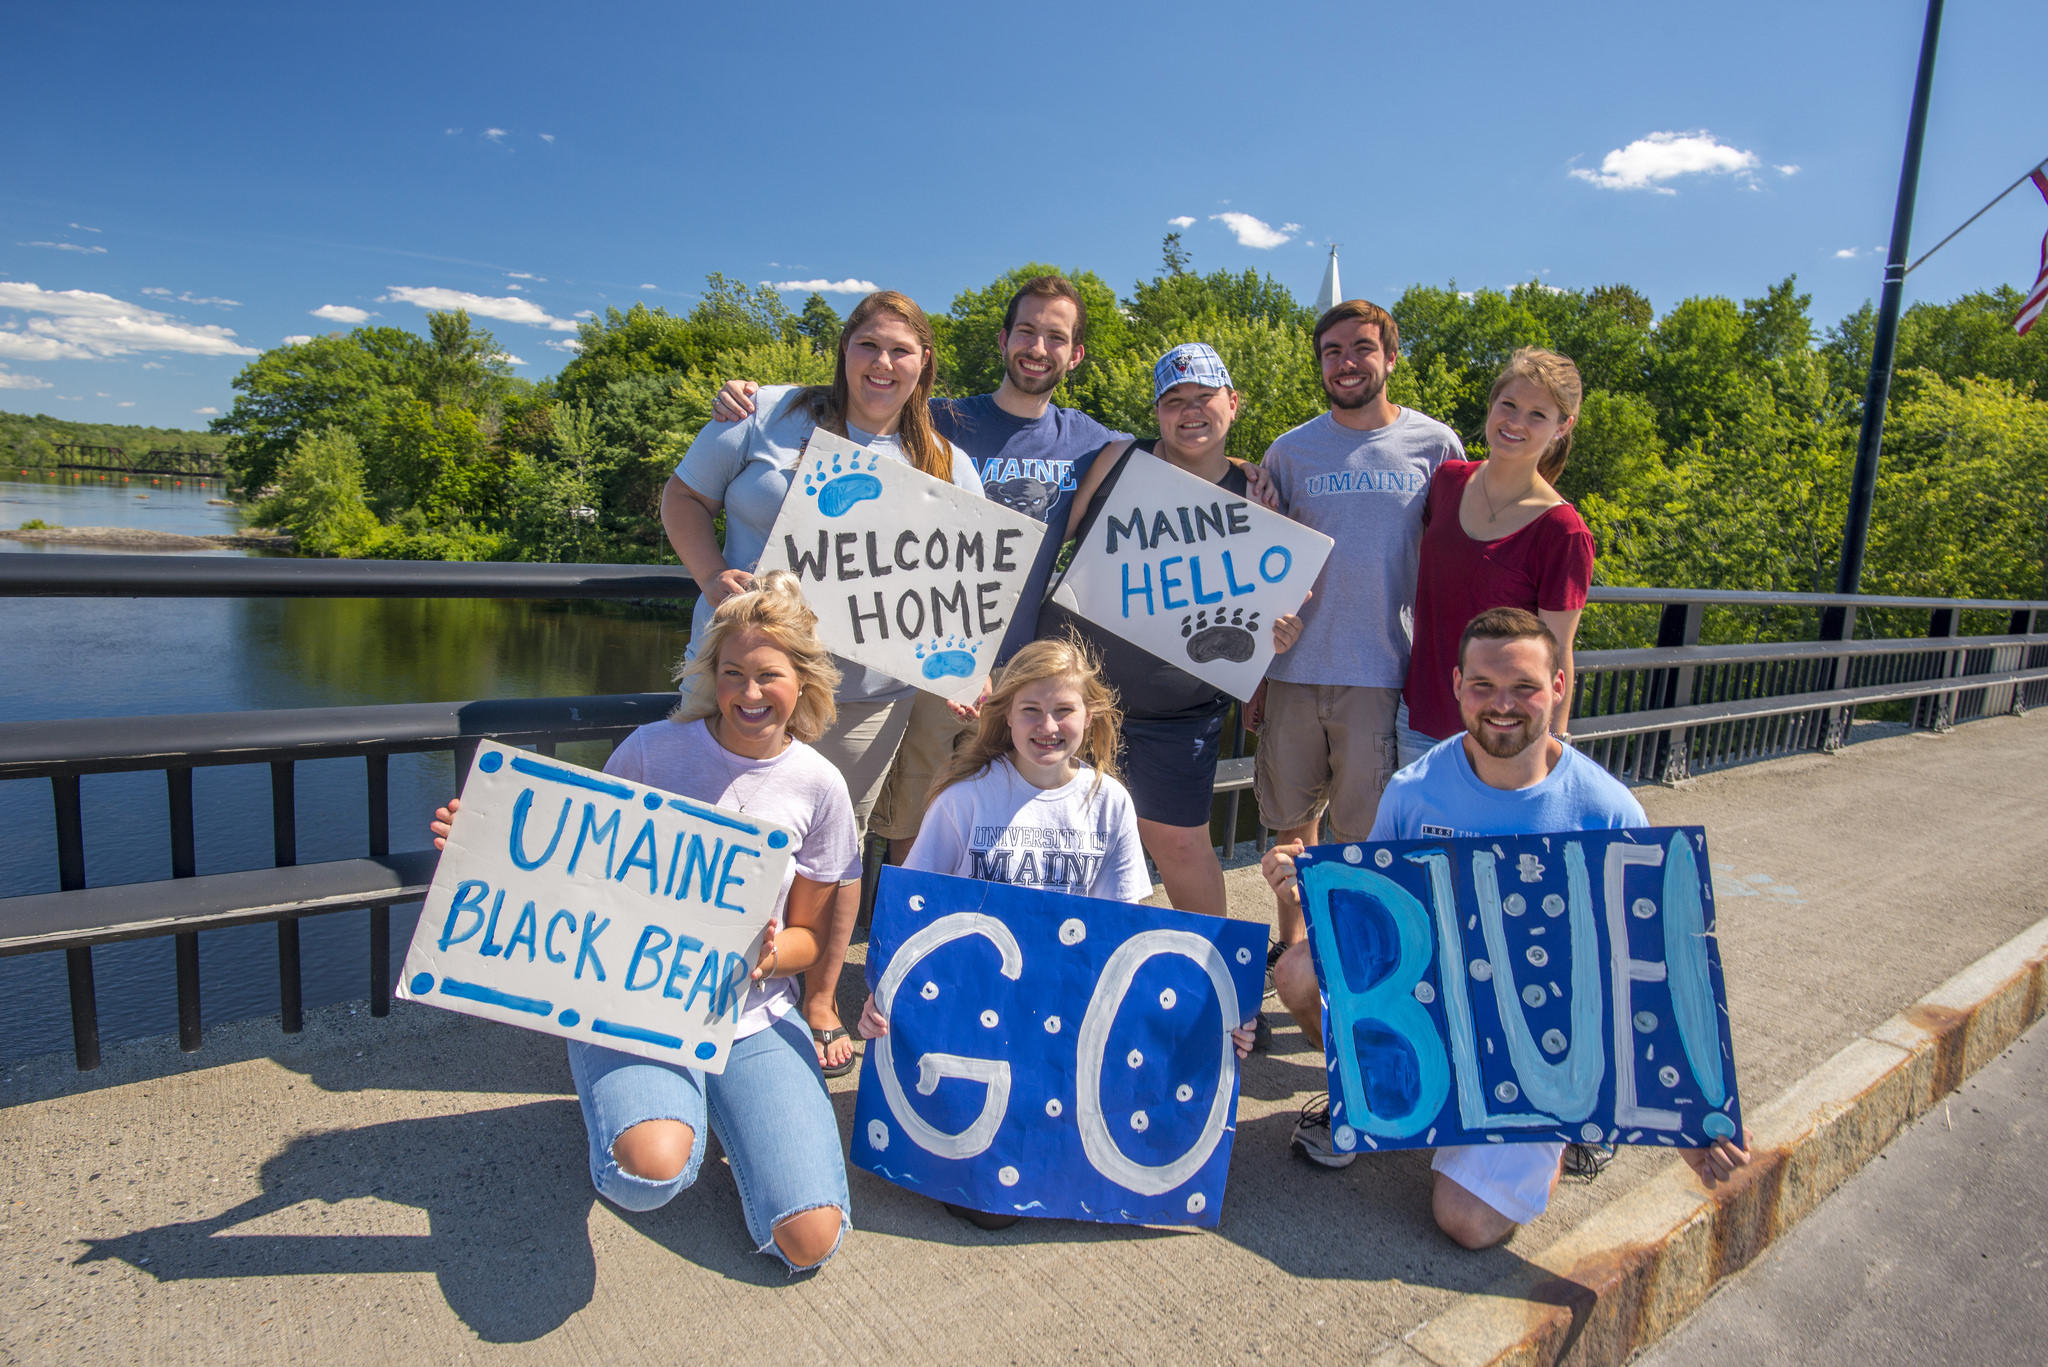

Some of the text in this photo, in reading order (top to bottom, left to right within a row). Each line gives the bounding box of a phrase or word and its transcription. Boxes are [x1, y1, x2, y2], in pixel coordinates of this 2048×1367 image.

[970, 457, 1078, 491] MAINE
[785, 528, 1023, 582] WELCOME
[1106, 501, 1251, 554] MAINE
[847, 580, 1003, 644] HOME
[1121, 545, 1293, 619] HELLO
[509, 788, 761, 914] UMAINE
[973, 826, 1086, 849] UNIVERSITY
[438, 880, 749, 1024] BLACK BEAR
[1302, 828, 1736, 1140] BLUE!
[874, 911, 1241, 1197] GO
